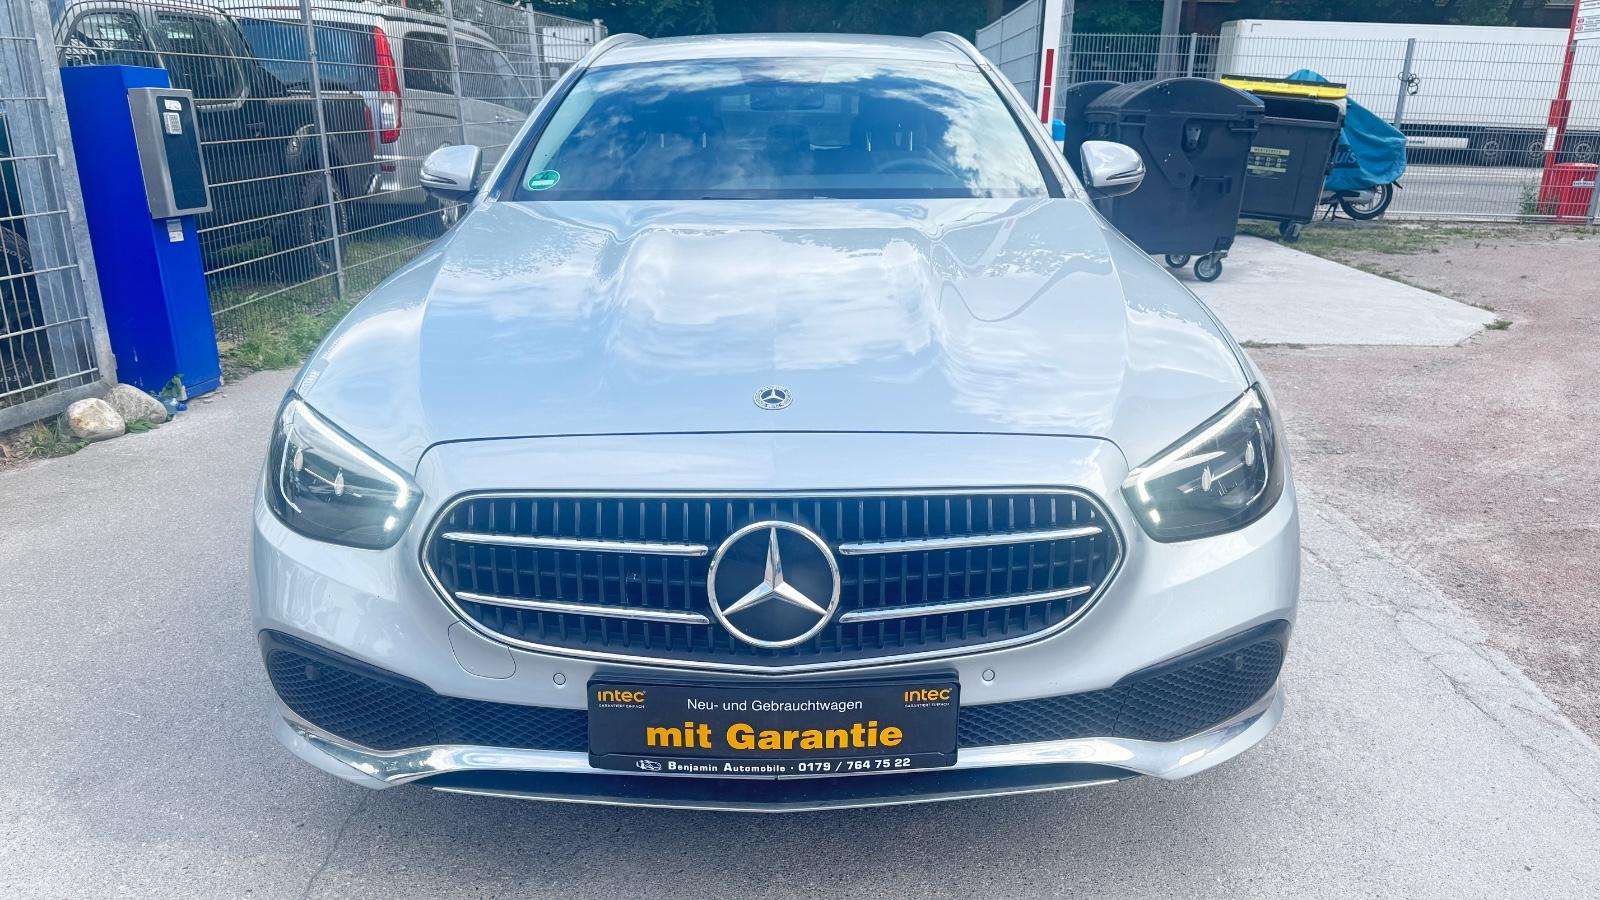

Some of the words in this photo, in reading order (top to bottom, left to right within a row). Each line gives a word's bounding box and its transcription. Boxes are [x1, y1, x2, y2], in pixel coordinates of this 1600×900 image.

[597, 689, 645, 703] intec
[904, 688, 950, 702] intec
[687, 699, 718, 710] Neu-
[723, 700, 747, 711] und
[751, 700, 863, 713] Gebrauchtwagen
[646, 722, 712, 748] mit
[726, 721, 903, 750] Garantie
[668, 761, 718, 772] Benjamin
[724, 762, 786, 773] Automobile
[798, 762, 831, 772] 0179
[847, 760, 870, 770] 764
[875, 759, 890, 769] 75
[895, 758, 911, 767] 22
